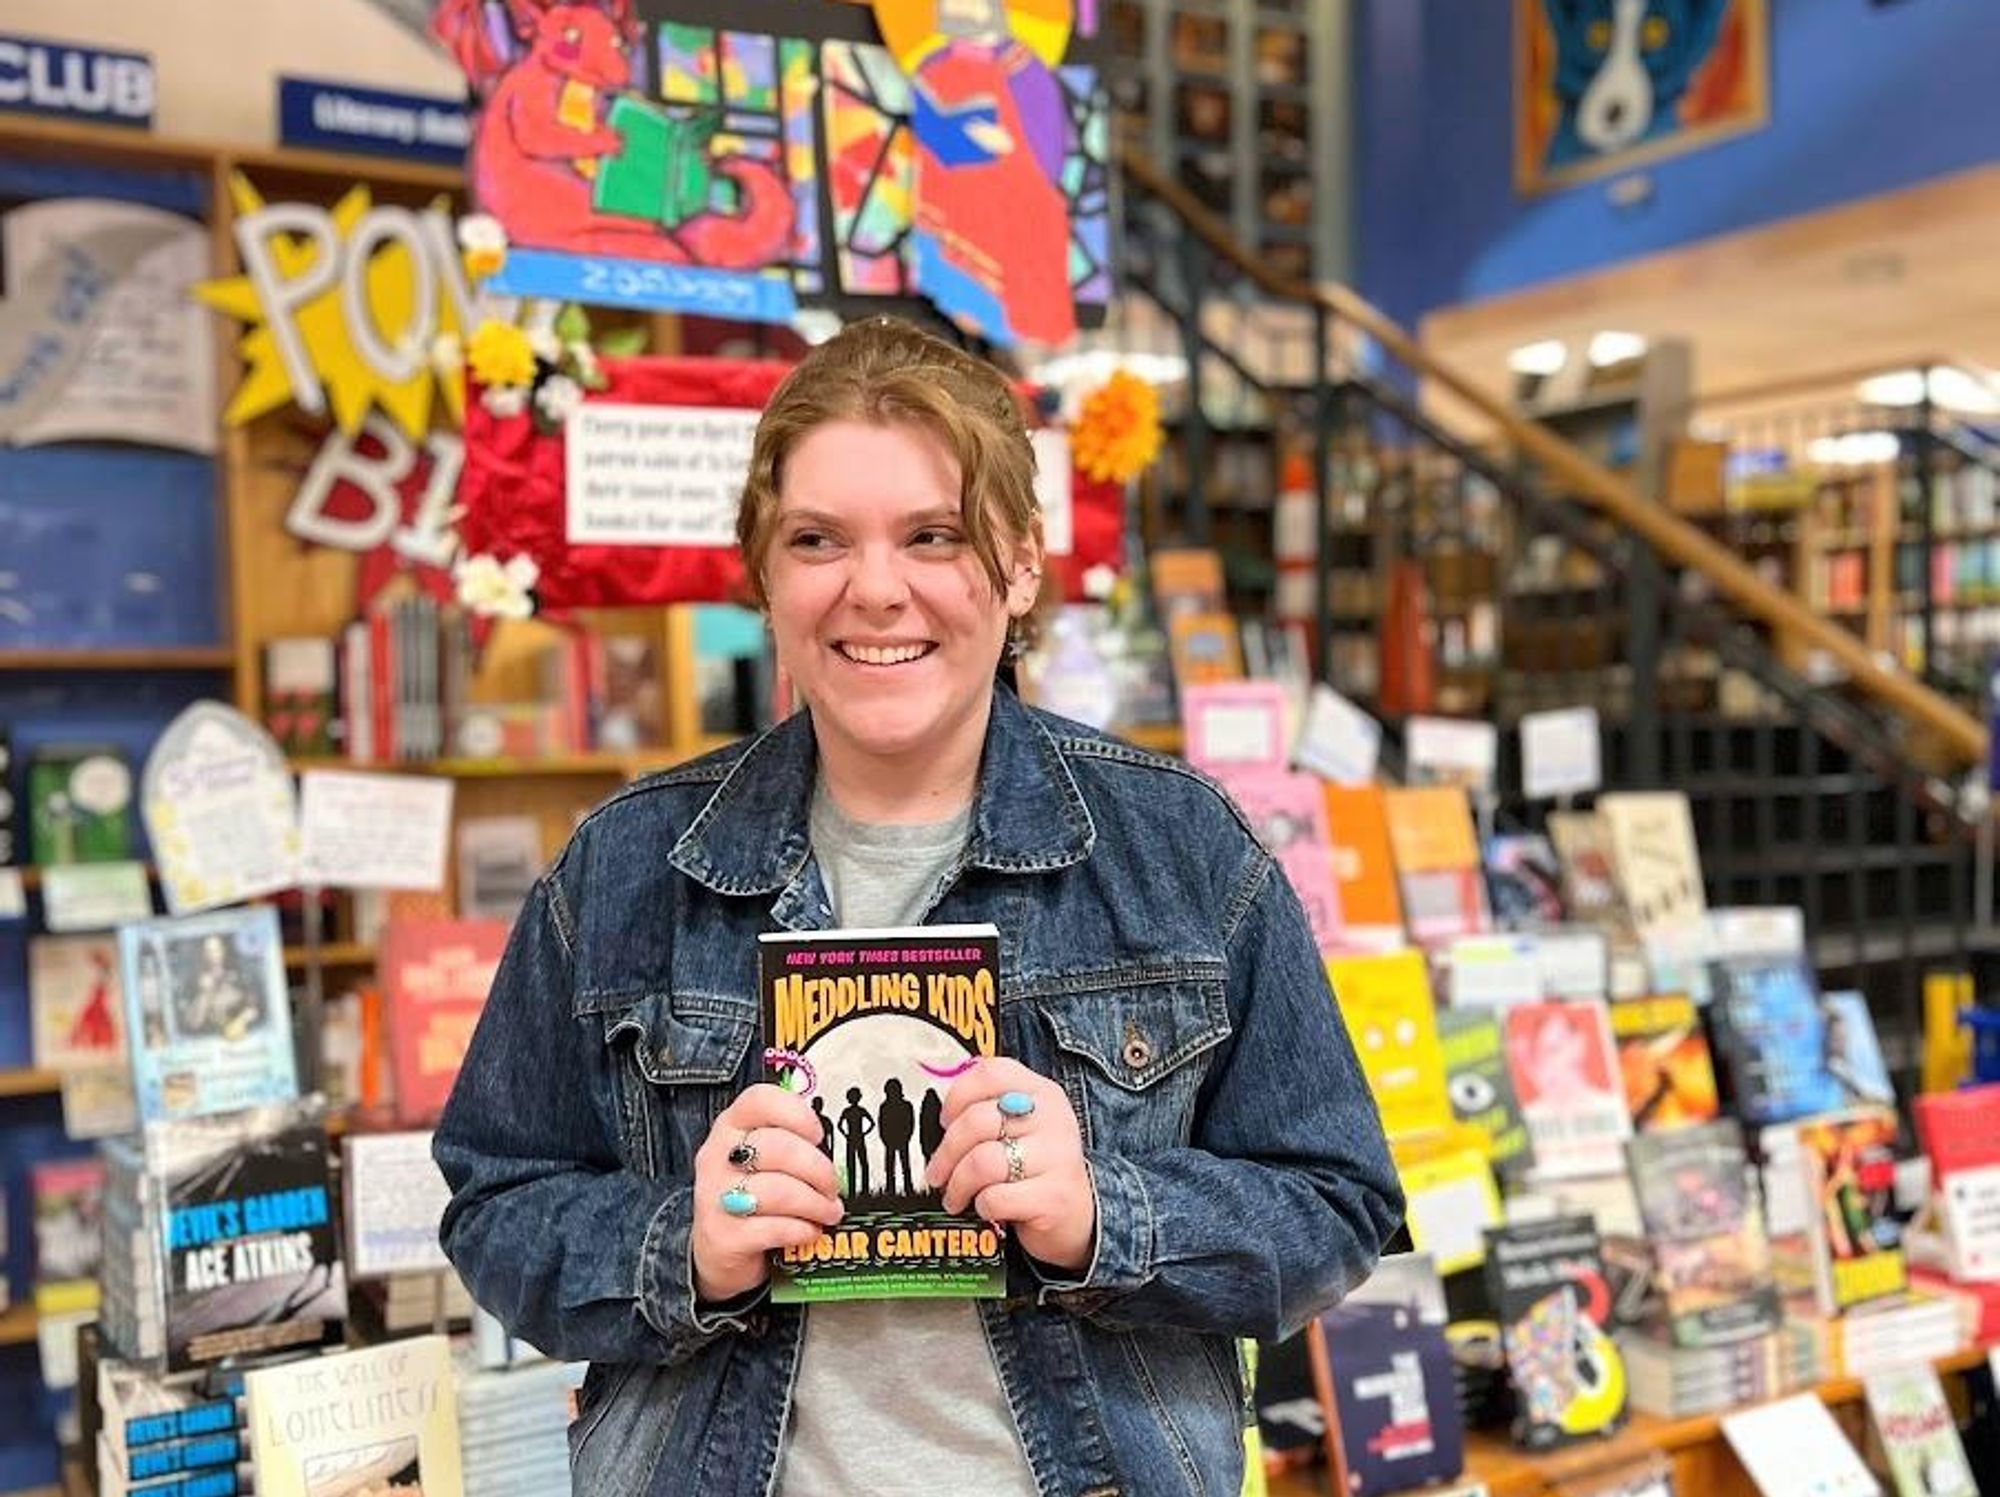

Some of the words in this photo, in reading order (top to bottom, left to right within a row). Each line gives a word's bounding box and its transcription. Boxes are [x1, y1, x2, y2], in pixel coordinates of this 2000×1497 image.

[0, 42, 153, 117] CLUB
[786, 952, 816, 965] NEW
[820, 951, 855, 965] YORK
[858, 949, 899, 963] TIMES
[901, 948, 982, 963] BESTSELLER
[774, 973, 921, 1053] MEDDLING
[926, 967, 996, 1056] KIDS
[185, 1245, 231, 1292] ACE
[233, 1231, 315, 1283] ATKINS
[784, 1232, 870, 1263] EDGAR
[876, 1228, 999, 1258] CANTERO
